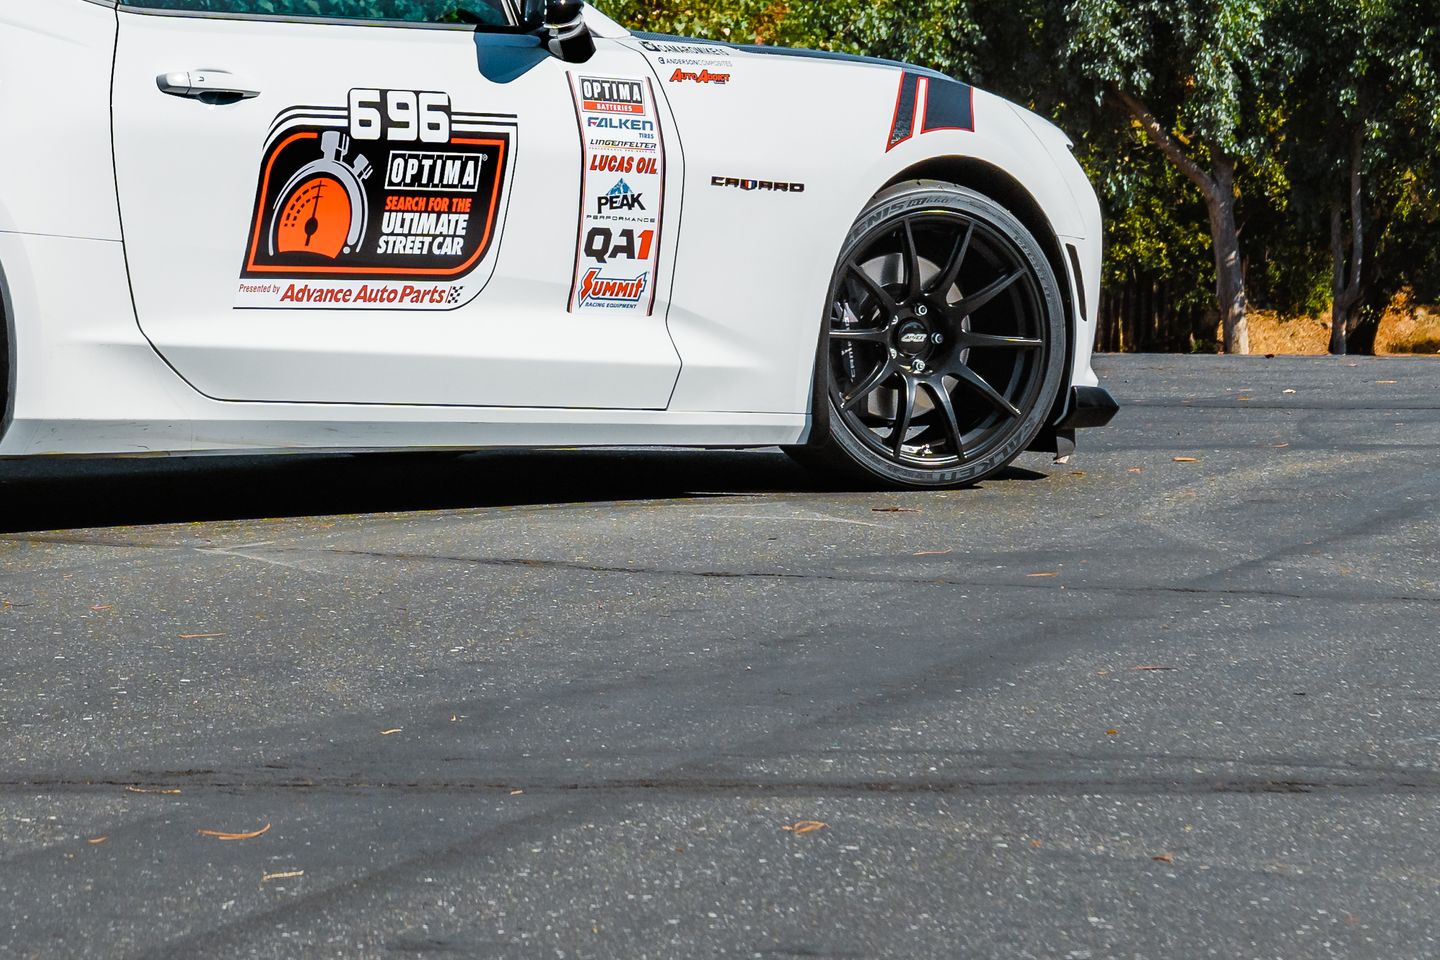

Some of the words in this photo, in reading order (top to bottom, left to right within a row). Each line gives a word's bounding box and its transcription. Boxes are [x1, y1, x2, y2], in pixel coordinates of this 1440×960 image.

[583, 81, 642, 101] OPTIMA
[349, 89, 451, 143] 696
[596, 103, 633, 112] BATTERIES
[587, 116, 654, 131] FALKEN
[590, 139, 657, 149] LINGENFELTER
[390, 157, 475, 185] OPTIMA
[589, 154, 634, 173] LUCAS
[636, 157, 658, 175] OIL
[384, 196, 427, 211] SEARCH
[427, 197, 450, 212] FOR
[452, 198, 473, 213] THE
[597, 193, 646, 214] PEAK
[381, 212, 469, 235] ULTIMATE
[586, 214, 656, 223] PERFORMANCE
[376, 235, 433, 254] STREET
[432, 236, 464, 255] CAR
[584, 227, 654, 264] QA1
[239, 284, 272, 293] Presented
[271, 285, 281, 294] by
[279, 283, 353, 303] Advance
[352, 284, 398, 303] Auto
[398, 285, 446, 304] Parts
